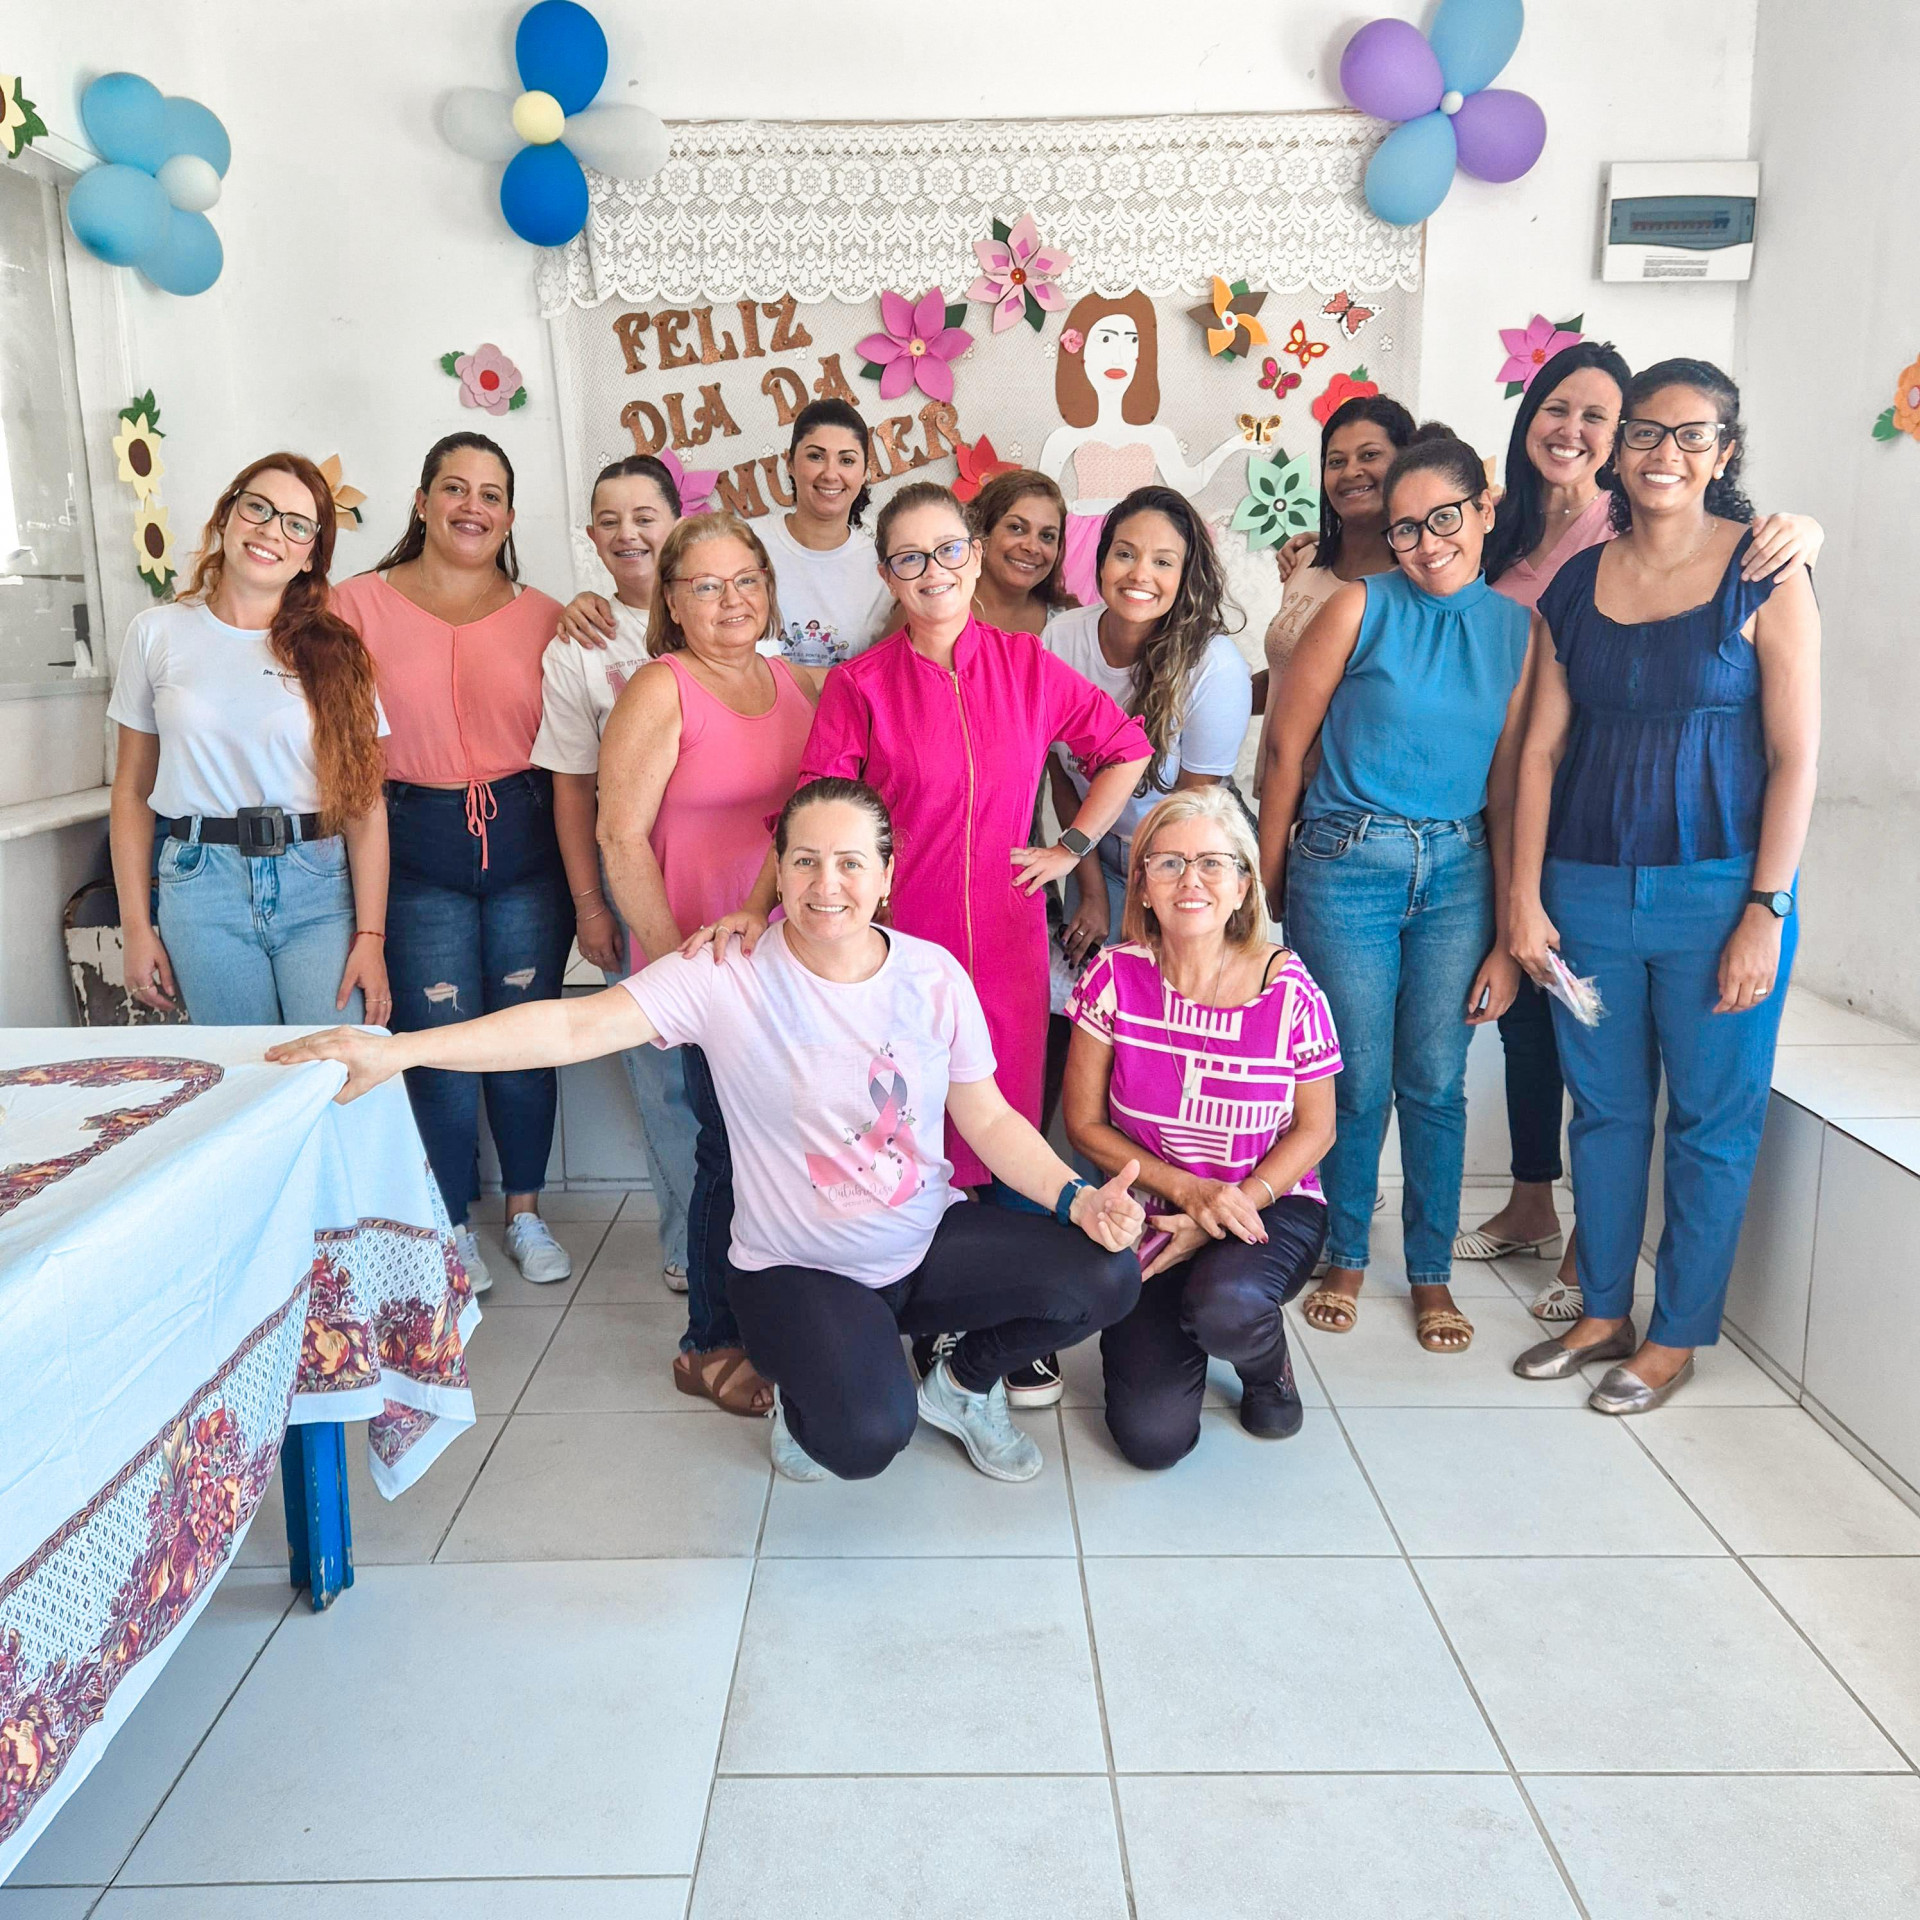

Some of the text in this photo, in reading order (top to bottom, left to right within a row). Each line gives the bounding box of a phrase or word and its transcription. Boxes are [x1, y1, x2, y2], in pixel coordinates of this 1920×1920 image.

[612, 293, 813, 374] FELIZ
[620, 353, 860, 456] DIA DA
[715, 400, 973, 519] MUER
